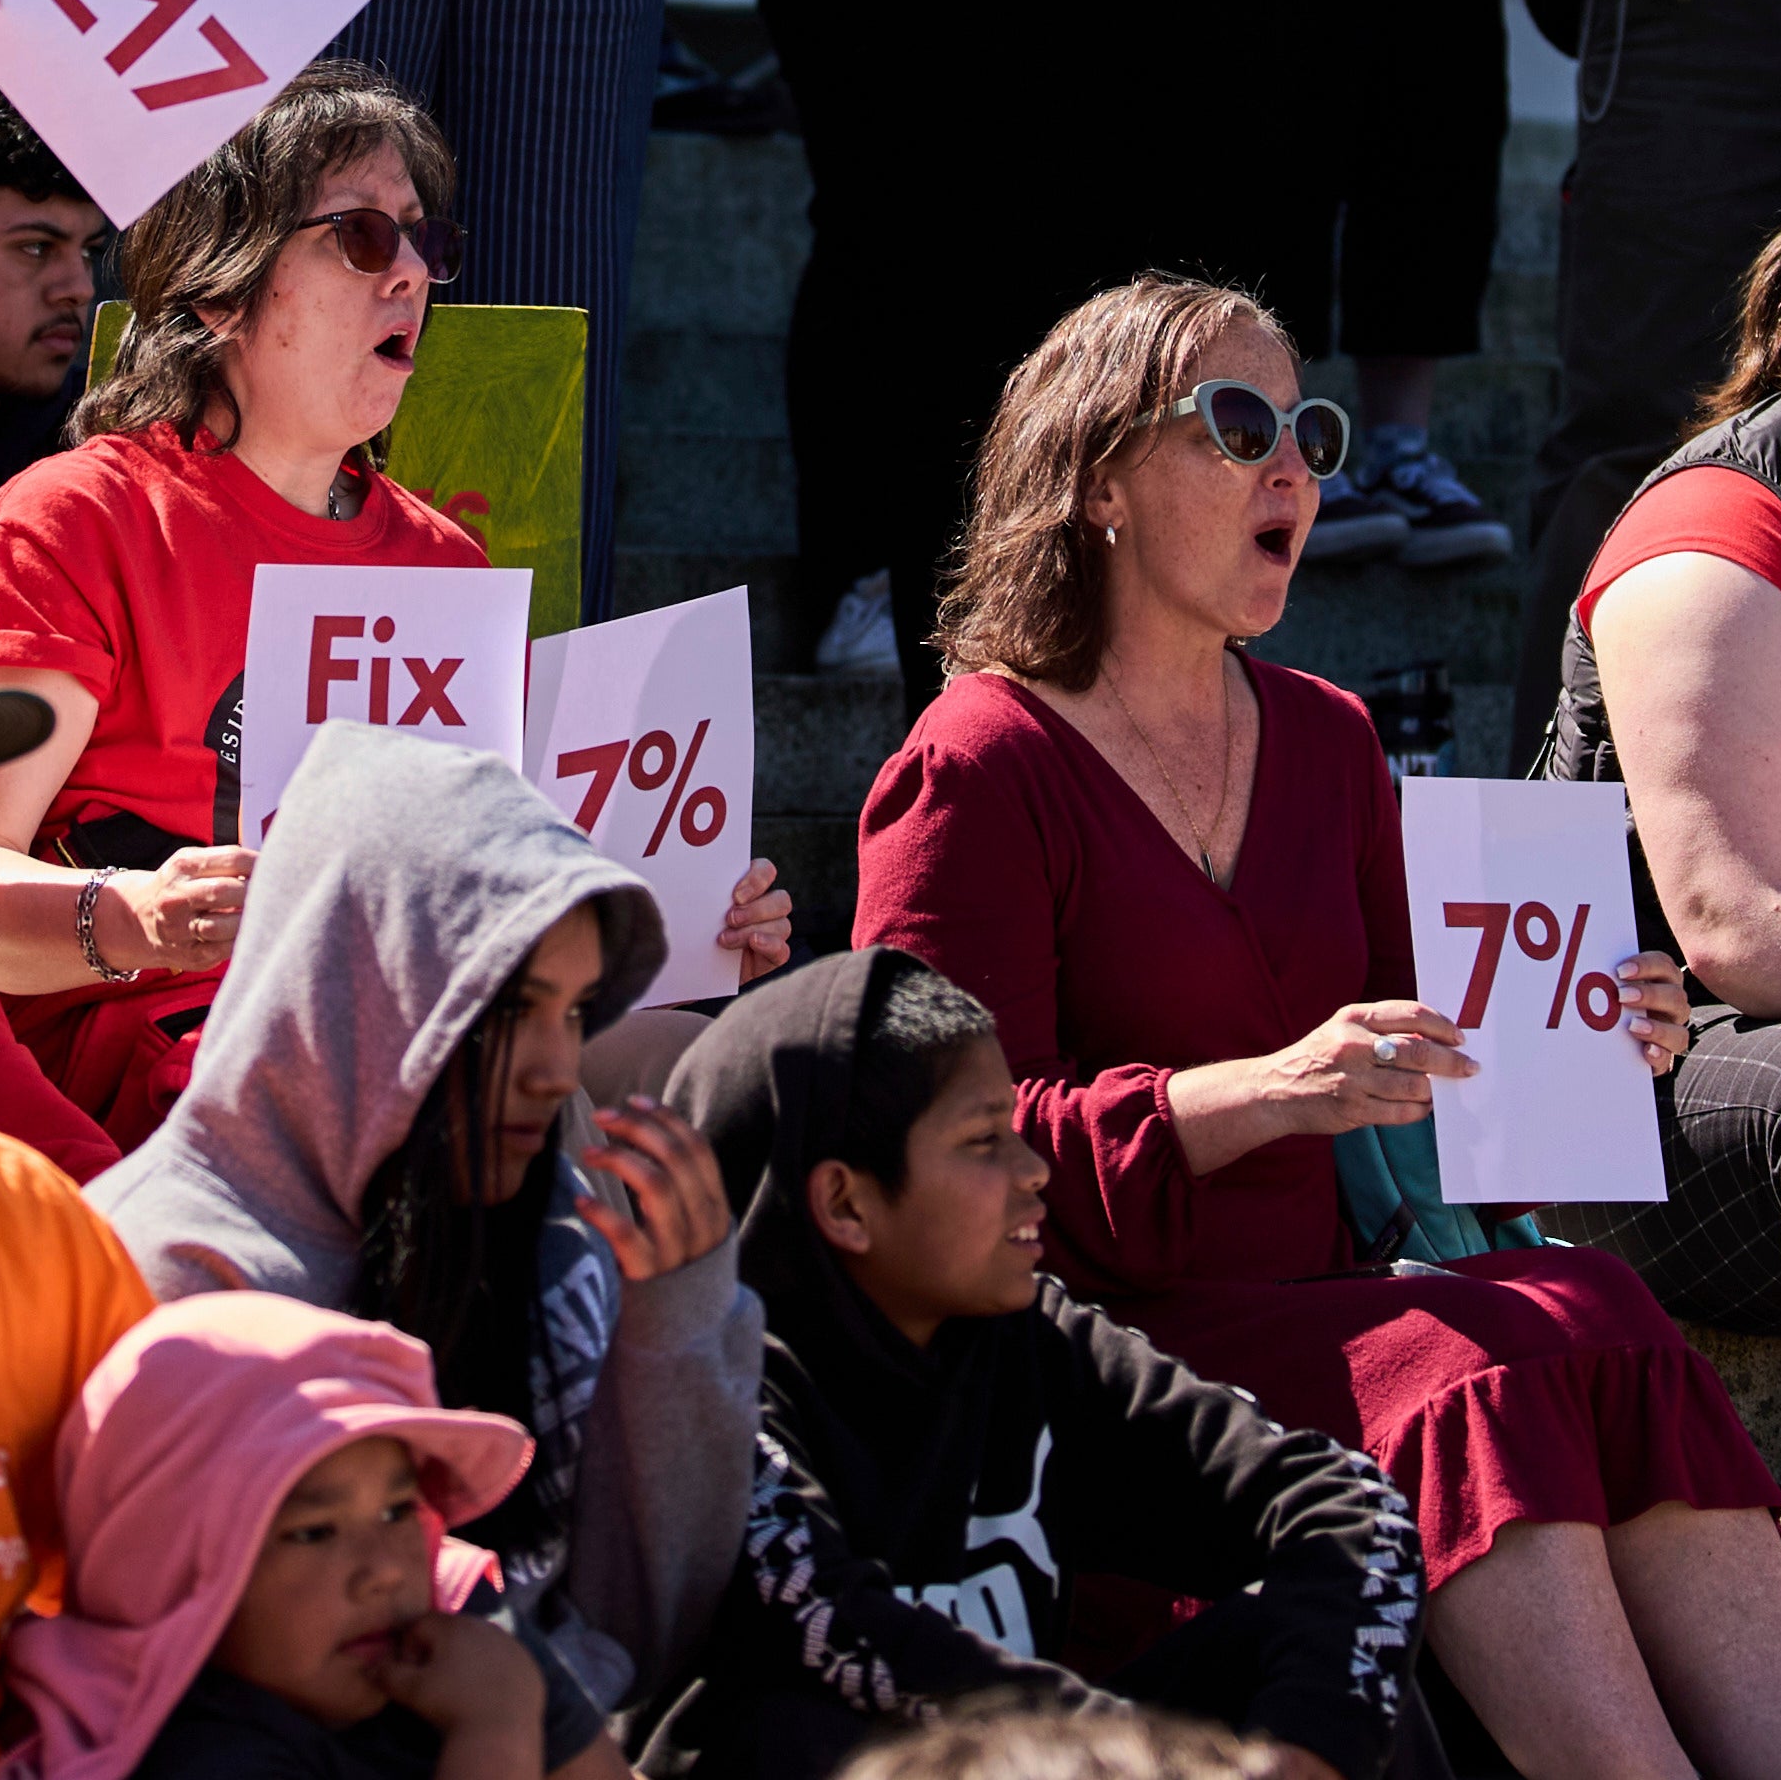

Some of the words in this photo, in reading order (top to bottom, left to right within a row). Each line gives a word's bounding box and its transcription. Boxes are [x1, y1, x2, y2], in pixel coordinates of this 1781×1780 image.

[306, 614, 467, 727] Fix
[556, 718, 727, 858] 7%
[1443, 900, 1621, 1031] 7%
